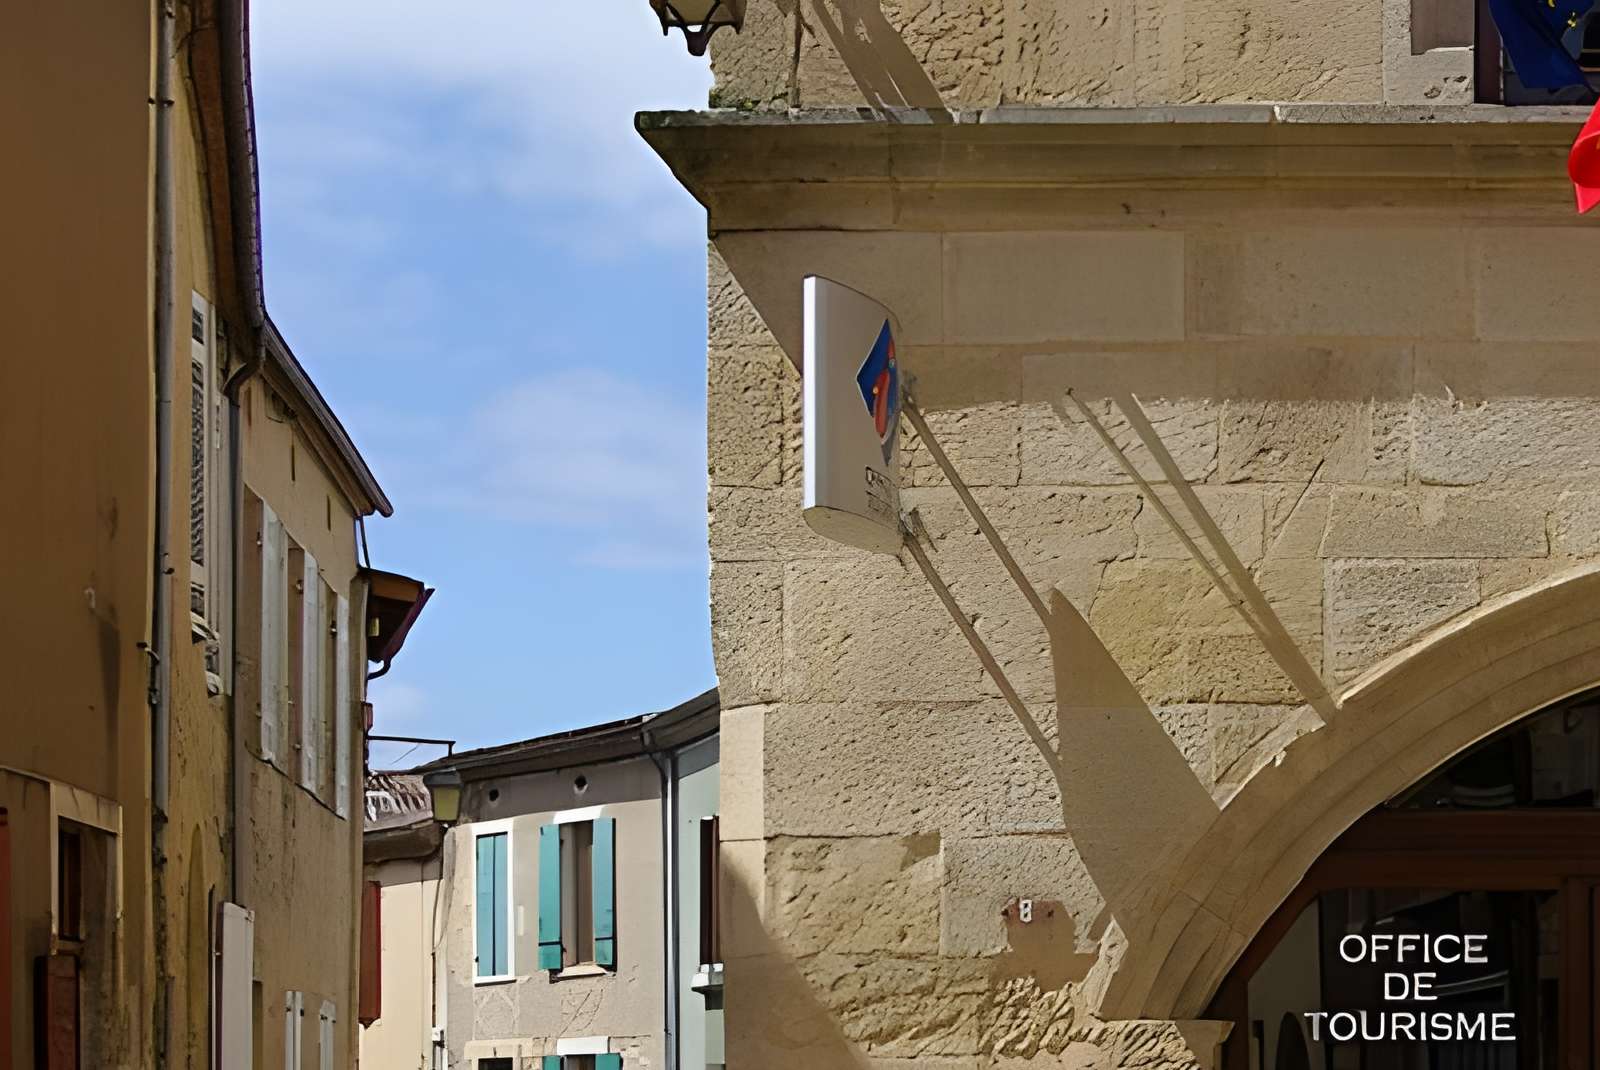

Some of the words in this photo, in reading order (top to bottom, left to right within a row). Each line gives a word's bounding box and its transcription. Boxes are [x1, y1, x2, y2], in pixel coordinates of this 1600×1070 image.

[1019, 899, 1032, 923] 8
[1340, 934, 1488, 963] OFFICE
[1385, 973, 1437, 1000] DE
[1304, 1011, 1516, 1040] TOURISME
